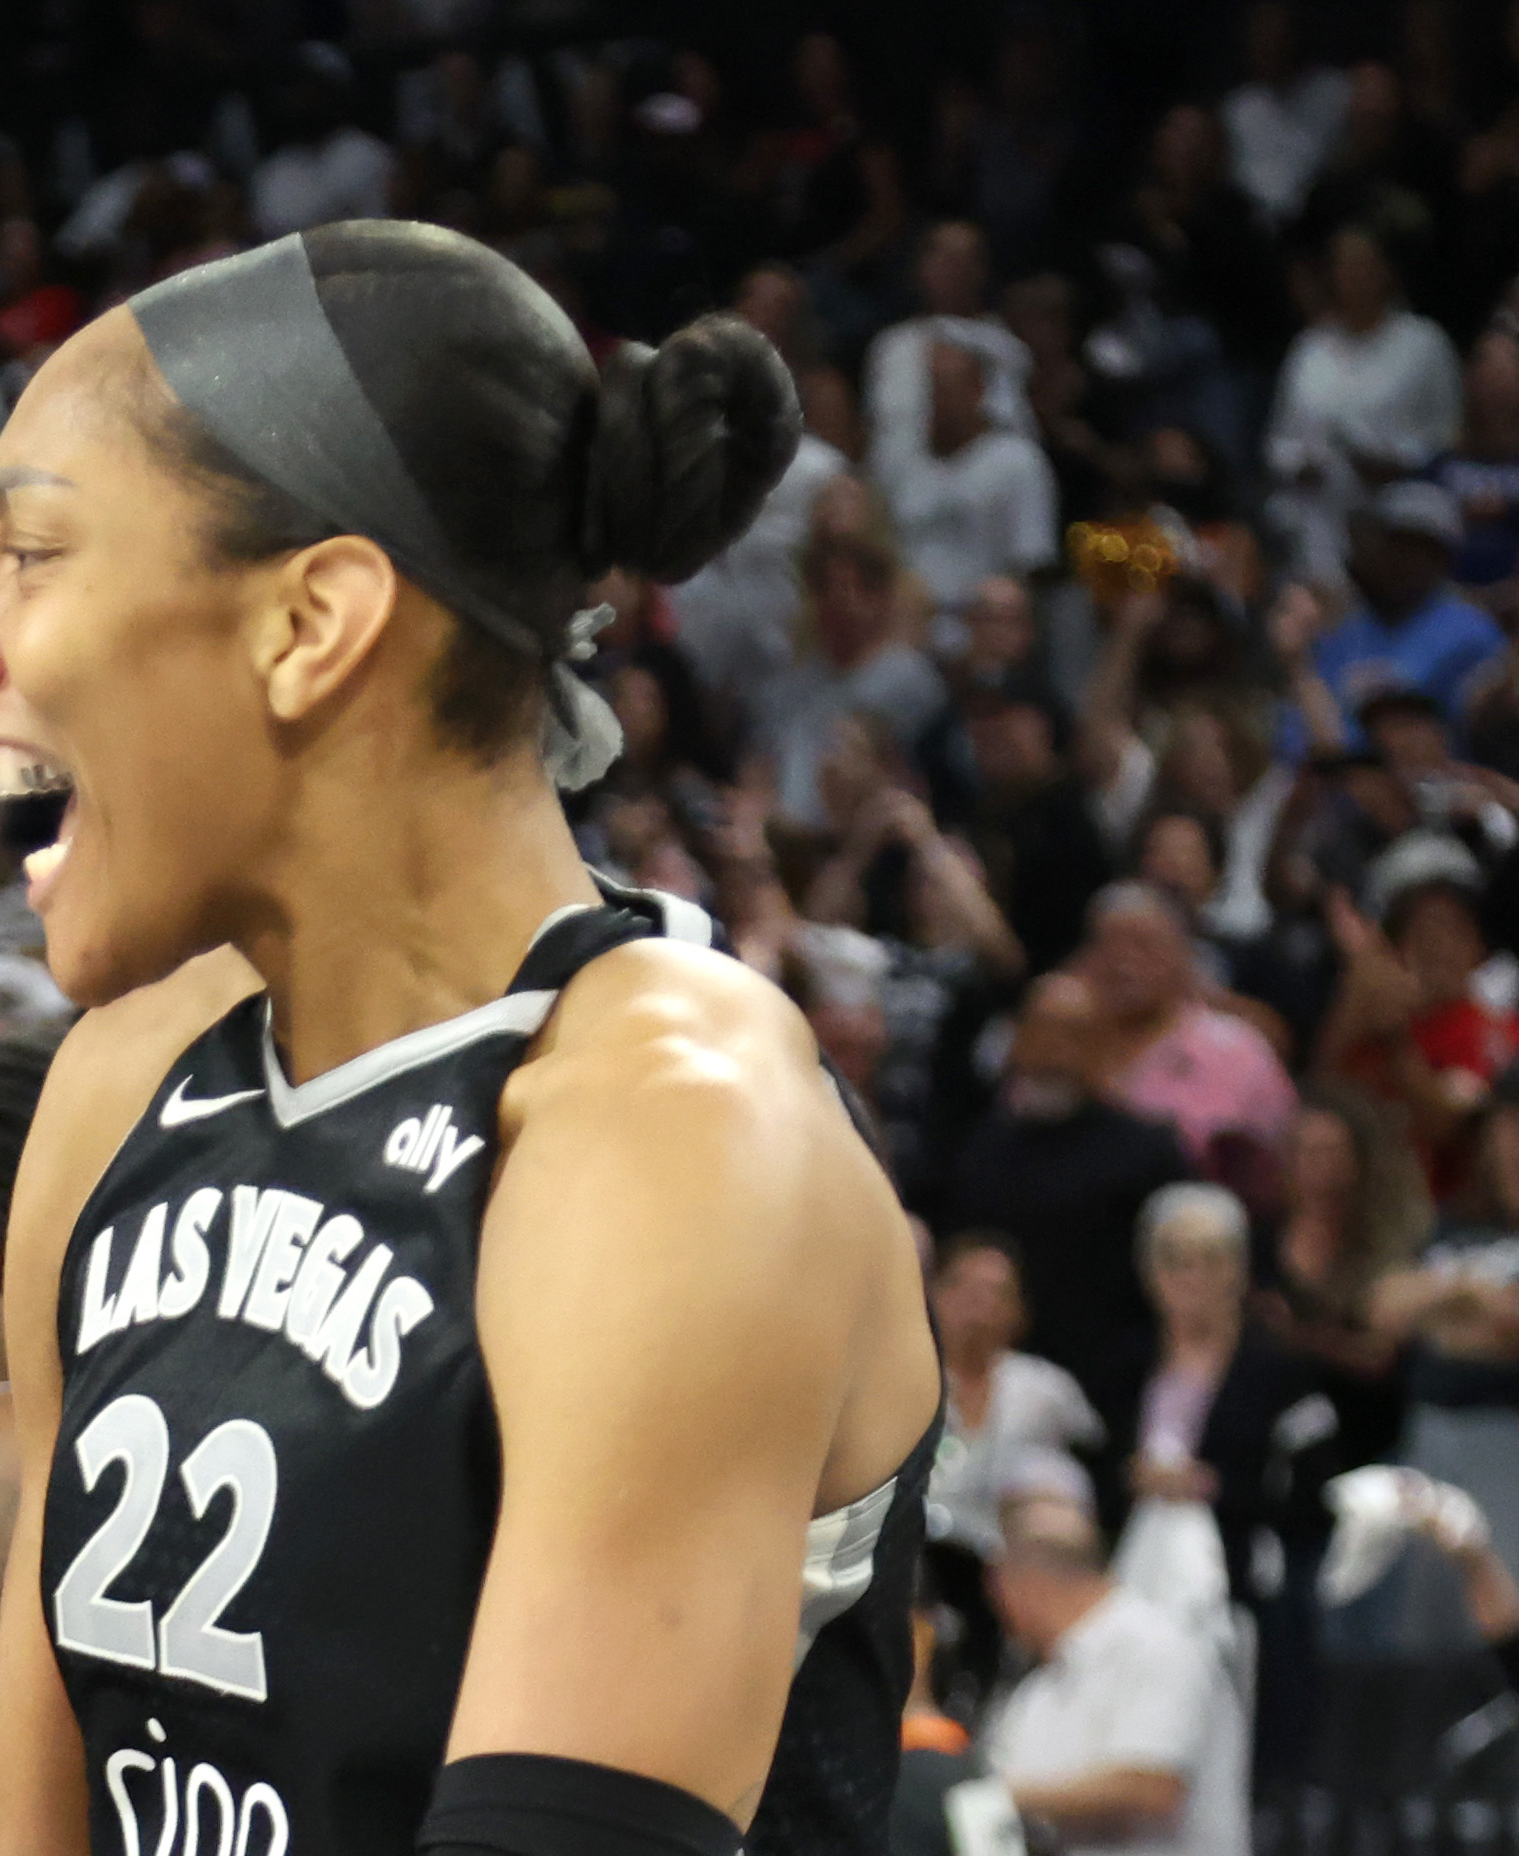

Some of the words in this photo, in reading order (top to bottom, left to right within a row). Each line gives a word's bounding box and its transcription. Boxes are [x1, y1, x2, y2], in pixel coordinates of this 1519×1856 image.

[384, 1103, 486, 1194] ally
[75, 1186, 223, 1355] LAS
[216, 1184, 435, 1410] VEGAS
[54, 1394, 279, 1702] 22
